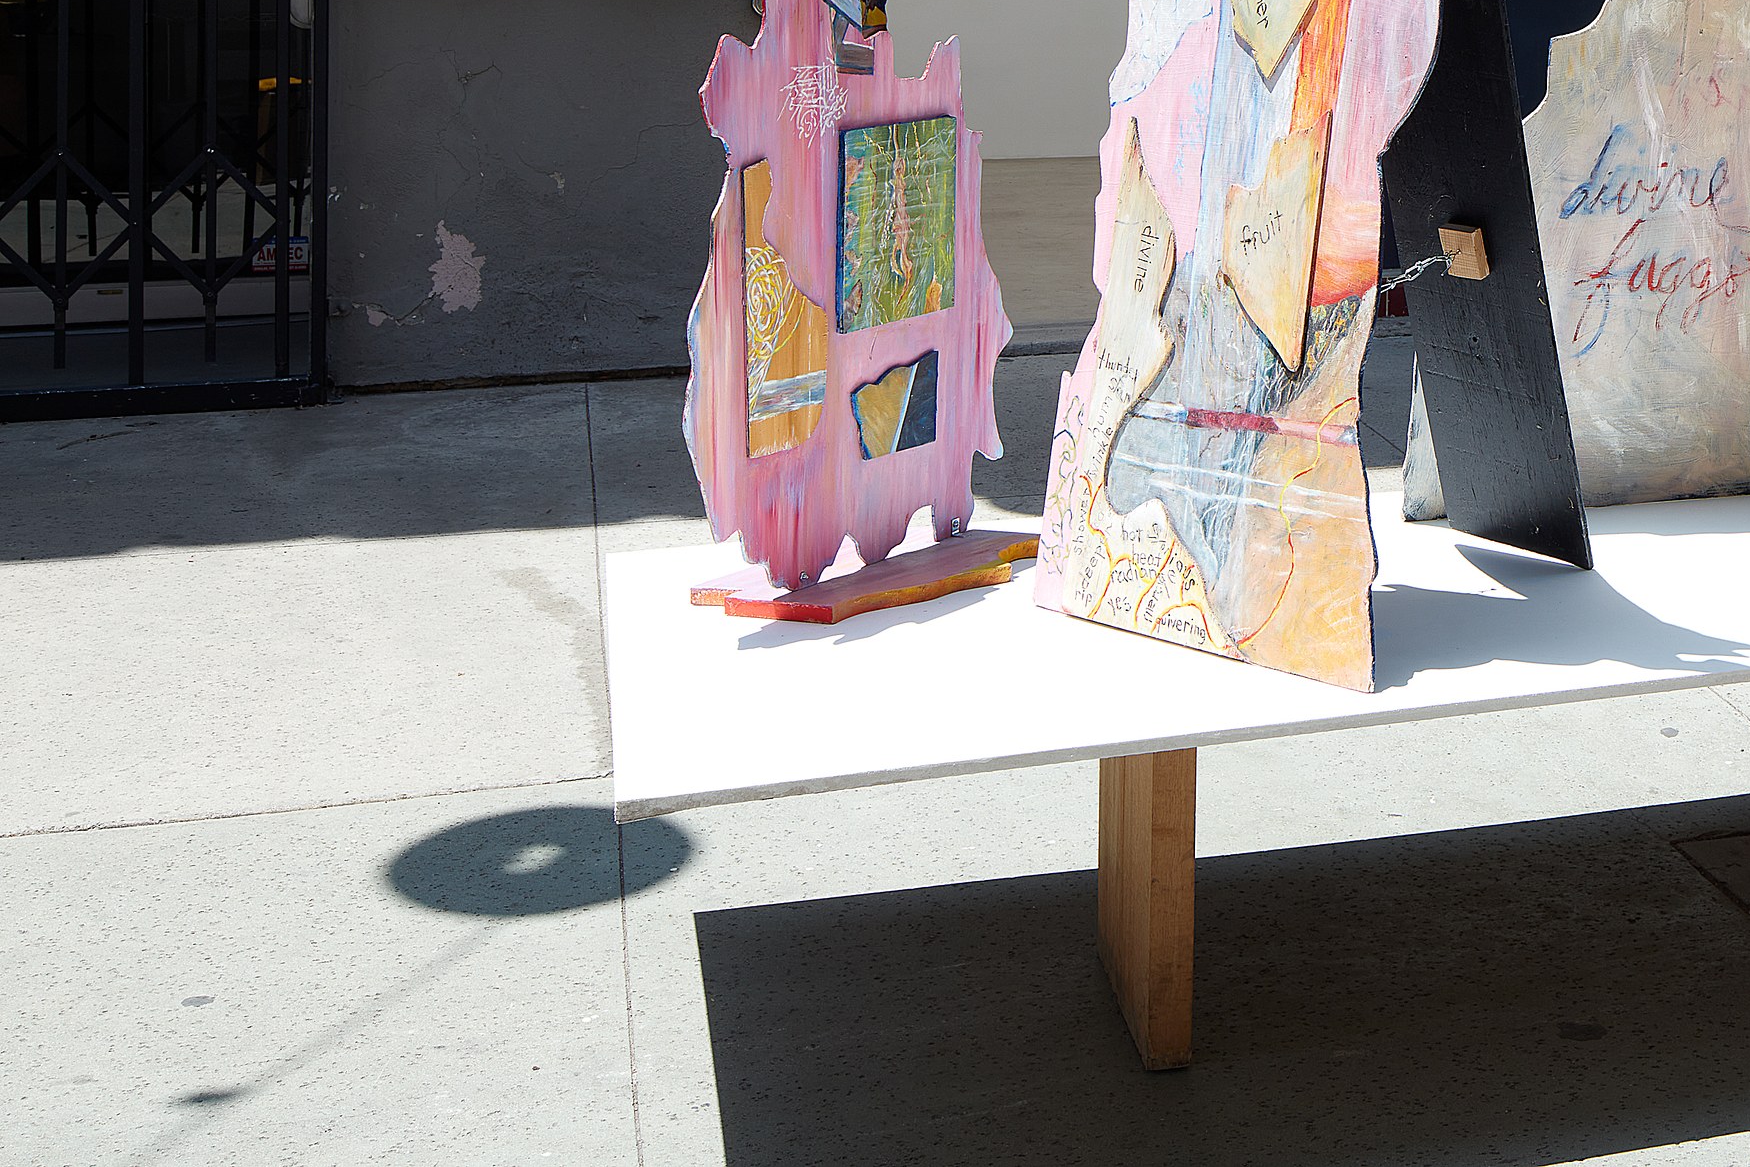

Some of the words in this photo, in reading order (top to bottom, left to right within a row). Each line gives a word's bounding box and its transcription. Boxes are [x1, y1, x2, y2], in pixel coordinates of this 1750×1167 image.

[1240, 210, 1283, 256] fruit
[256, 246, 304, 261] AMEC
[1134, 225, 1160, 293] divine
[1155, 613, 1206, 645] quivering
